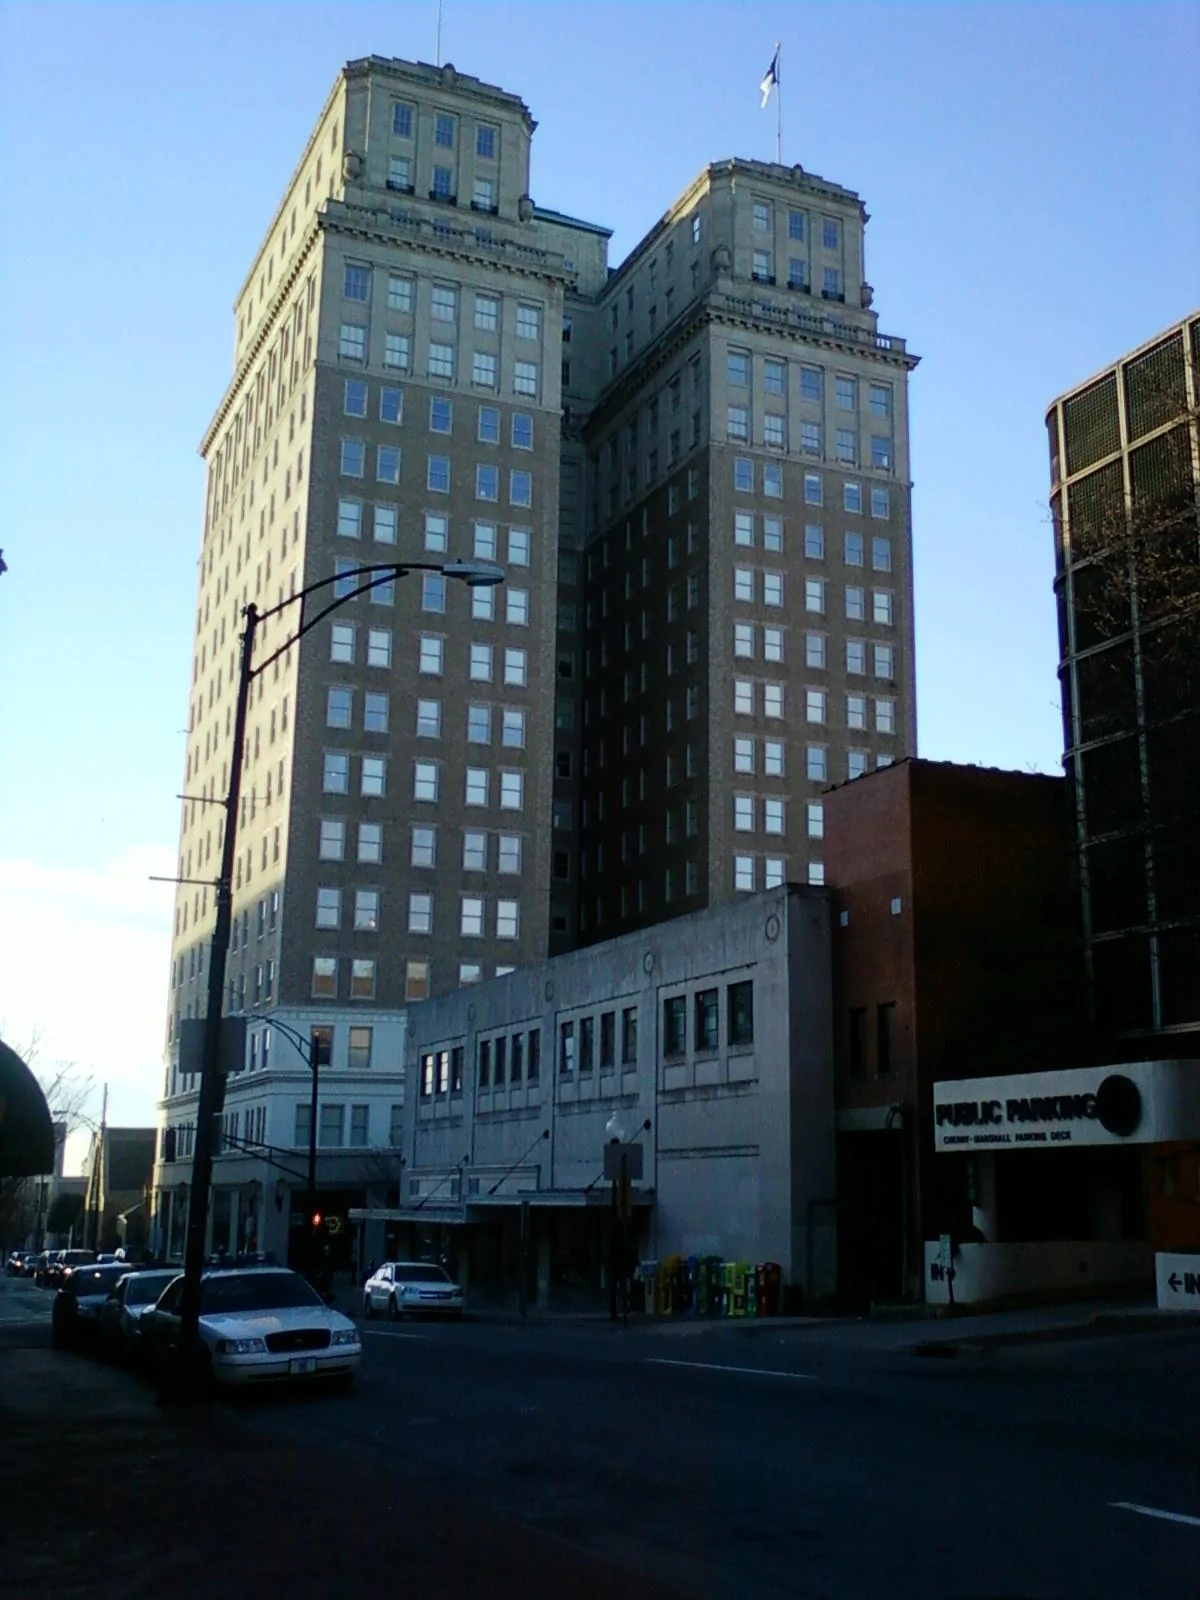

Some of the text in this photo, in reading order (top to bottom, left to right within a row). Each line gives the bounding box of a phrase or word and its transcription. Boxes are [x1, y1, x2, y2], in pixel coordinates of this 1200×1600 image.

[936, 1093, 1098, 1126] PUBLIC PARKING
[1015, 1132, 1047, 1141] PARKING
[1051, 1131, 1072, 1140] DECK
[931, 1264, 944, 1280] IN
